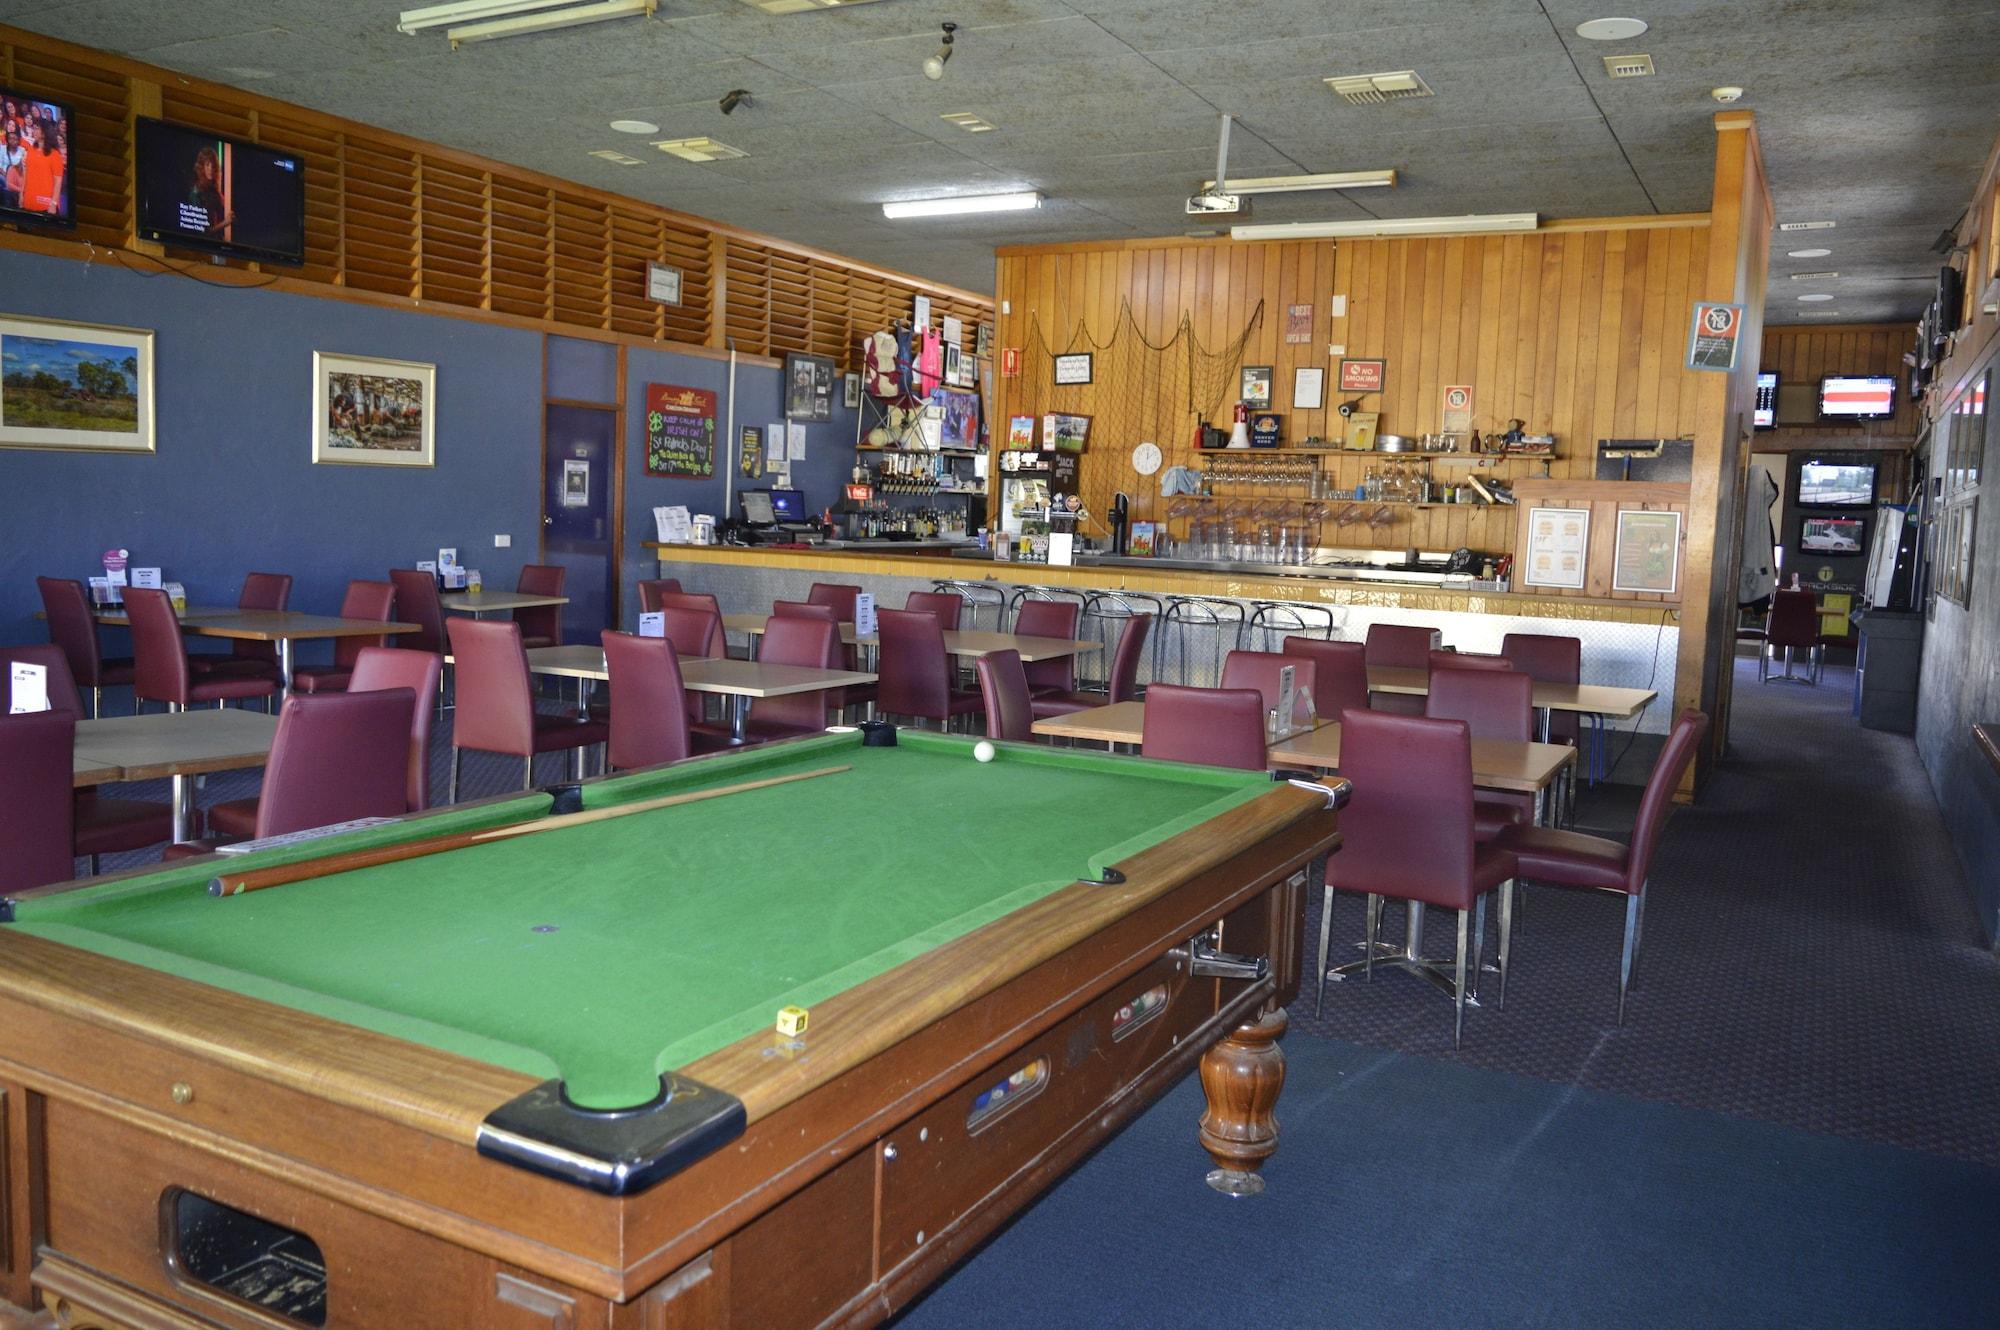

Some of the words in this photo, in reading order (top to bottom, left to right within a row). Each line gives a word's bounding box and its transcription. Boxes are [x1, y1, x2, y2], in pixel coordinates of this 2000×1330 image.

[1361, 368, 1374, 376] NO
[1345, 375, 1379, 383] SMOKING
[679, 417, 696, 426] CALM
[1033, 539, 1048, 547] WIN
